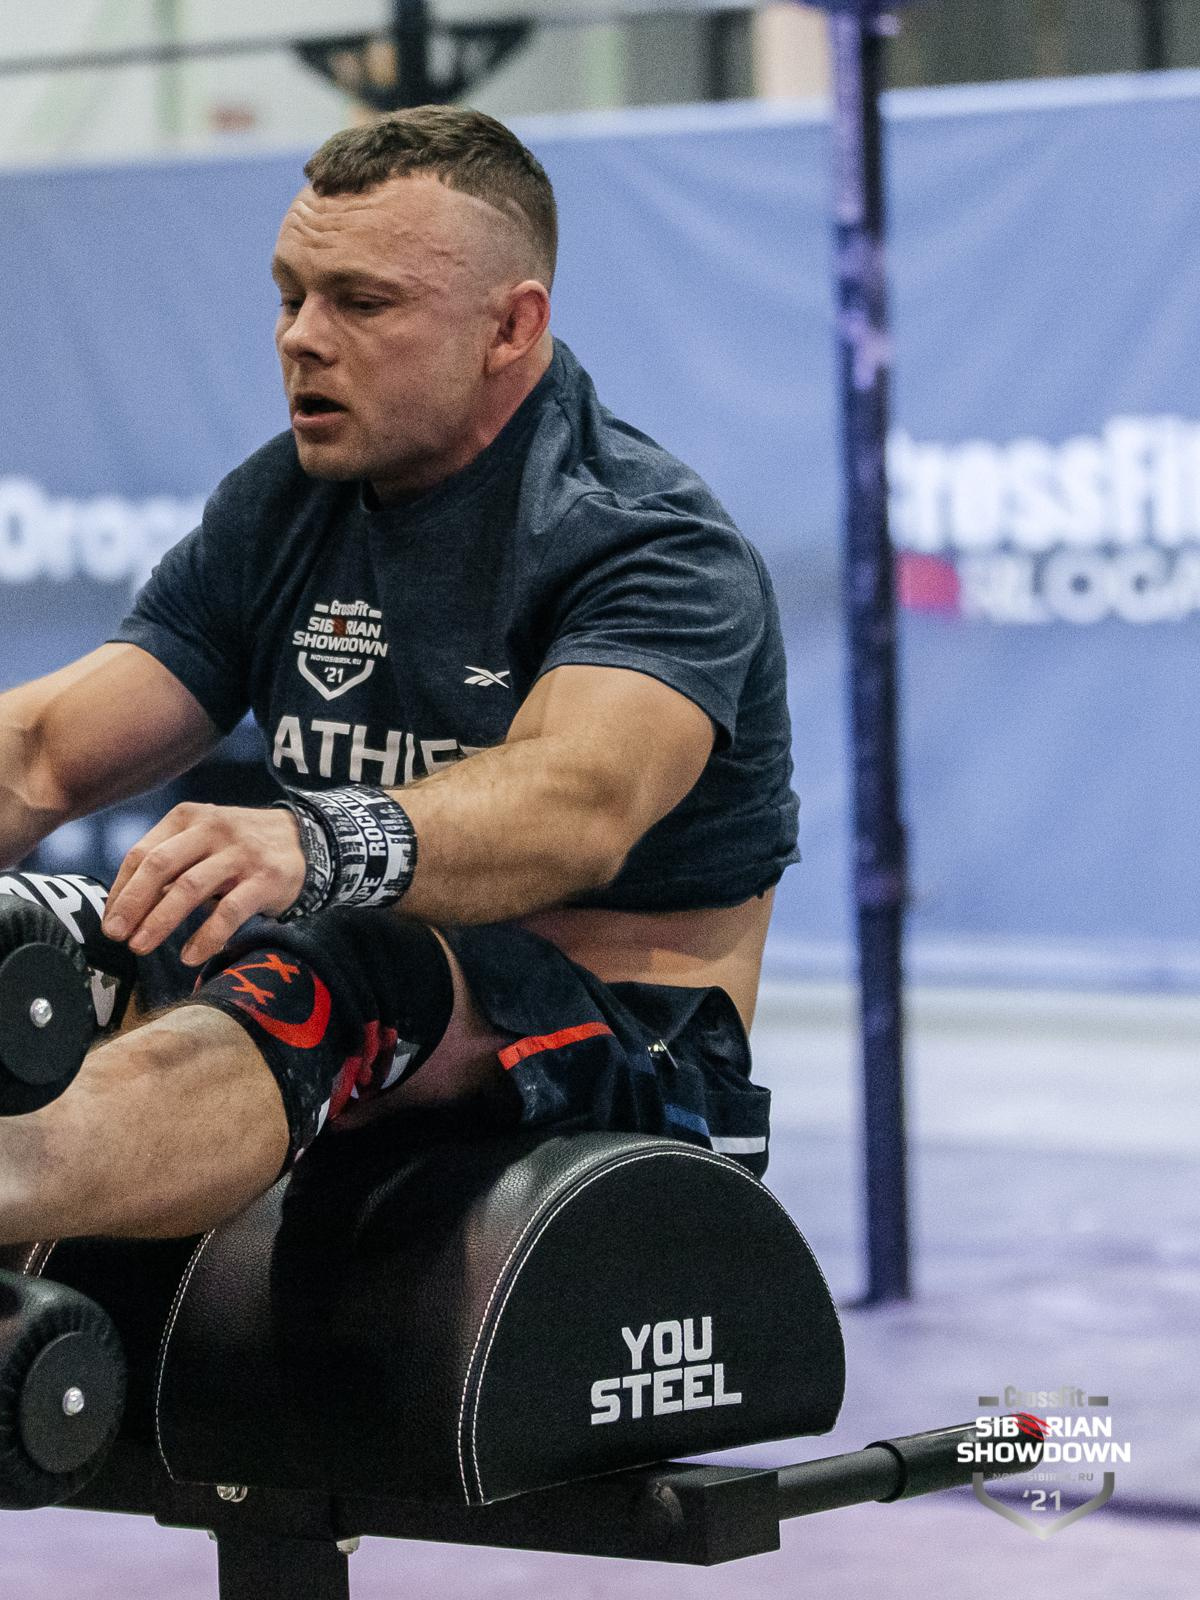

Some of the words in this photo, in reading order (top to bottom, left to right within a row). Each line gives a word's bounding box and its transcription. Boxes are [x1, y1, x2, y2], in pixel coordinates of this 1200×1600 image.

[330, 599, 370, 617] CrossFit
[307, 616, 381, 639] SIBRIAN
[292, 630, 389, 657] SHOWDOWN
[621, 1316, 713, 1370] YOU
[590, 1363, 743, 1425] STEEL
